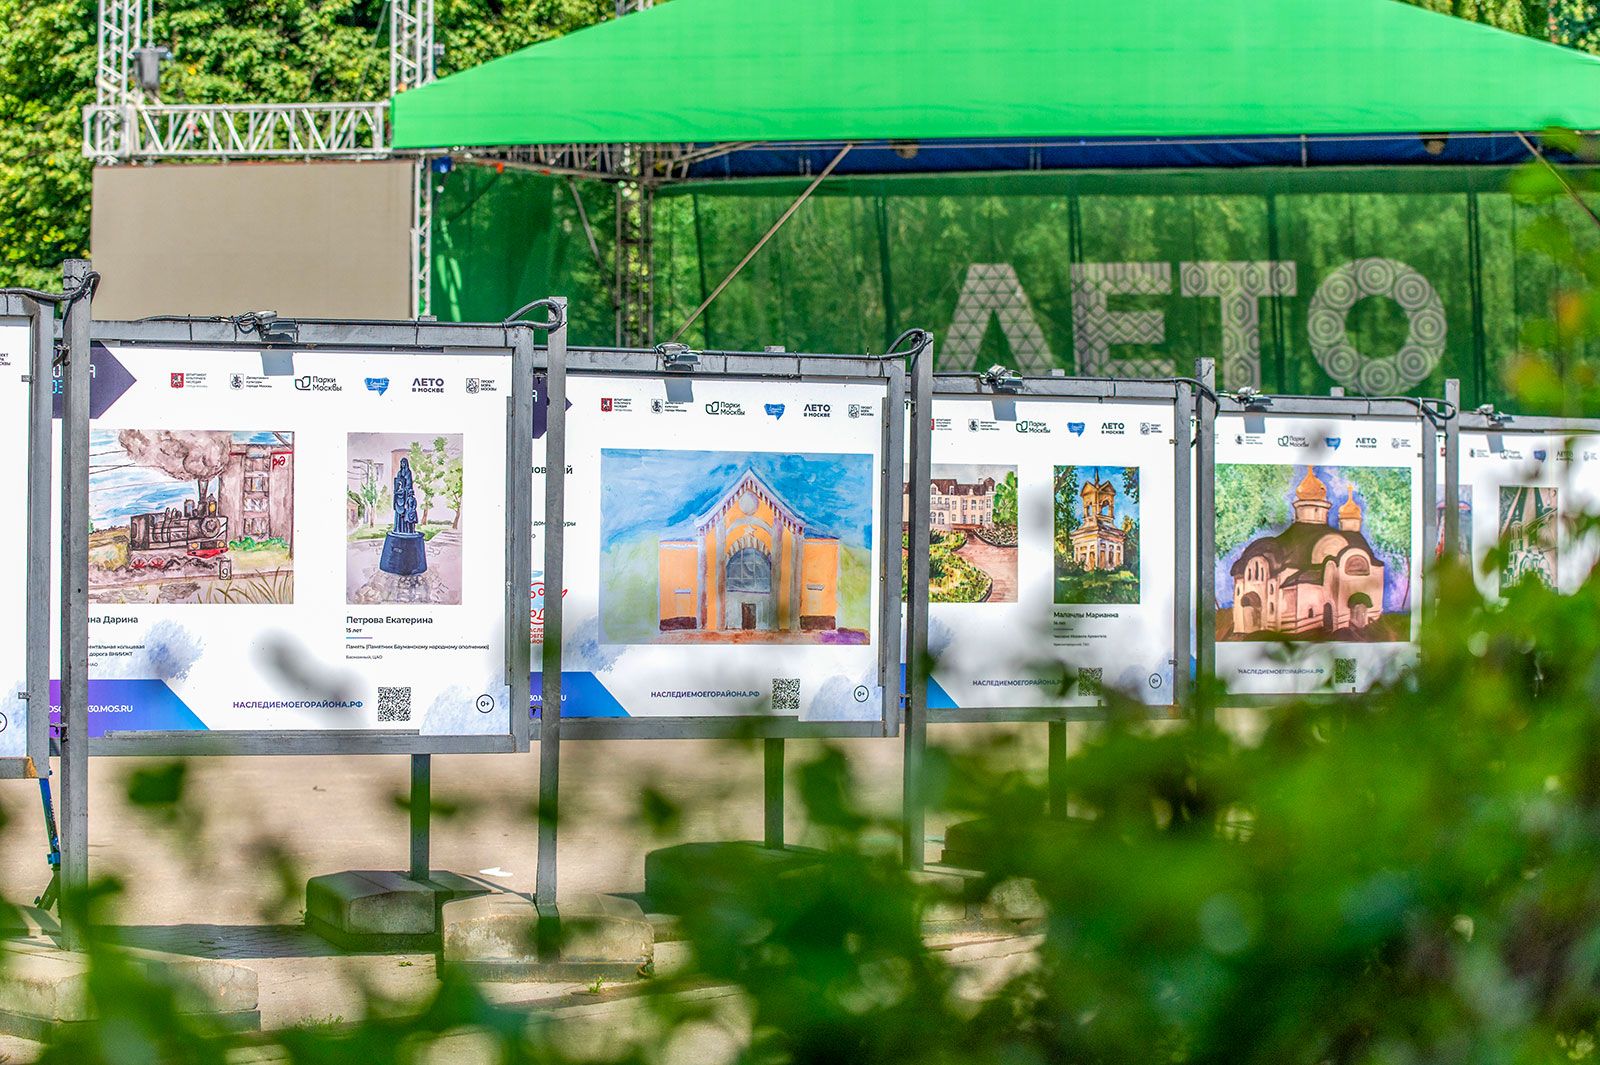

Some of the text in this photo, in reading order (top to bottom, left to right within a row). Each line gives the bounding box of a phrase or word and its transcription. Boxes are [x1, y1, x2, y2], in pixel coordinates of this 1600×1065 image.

[936, 257, 1448, 396] ЛЕТО
[313, 376, 336, 386] Парки
[412, 378, 445, 387] ЛЕТО
[312, 384, 343, 392] Москвы
[720, 402, 740, 410] Парки
[804, 404, 831, 412] ЛЕТО
[720, 408, 746, 416] Москвы
[103, 616, 138, 625] Дарина
[346, 616, 433, 625] Петрова Екатерина
[651, 690, 760, 699] НАСЛЕДИЕМОЕГОРАЙОНА.РФ
[233, 700, 363, 710] НАСЛЕДИЕМОЕГОРАЙОНА.РФ
